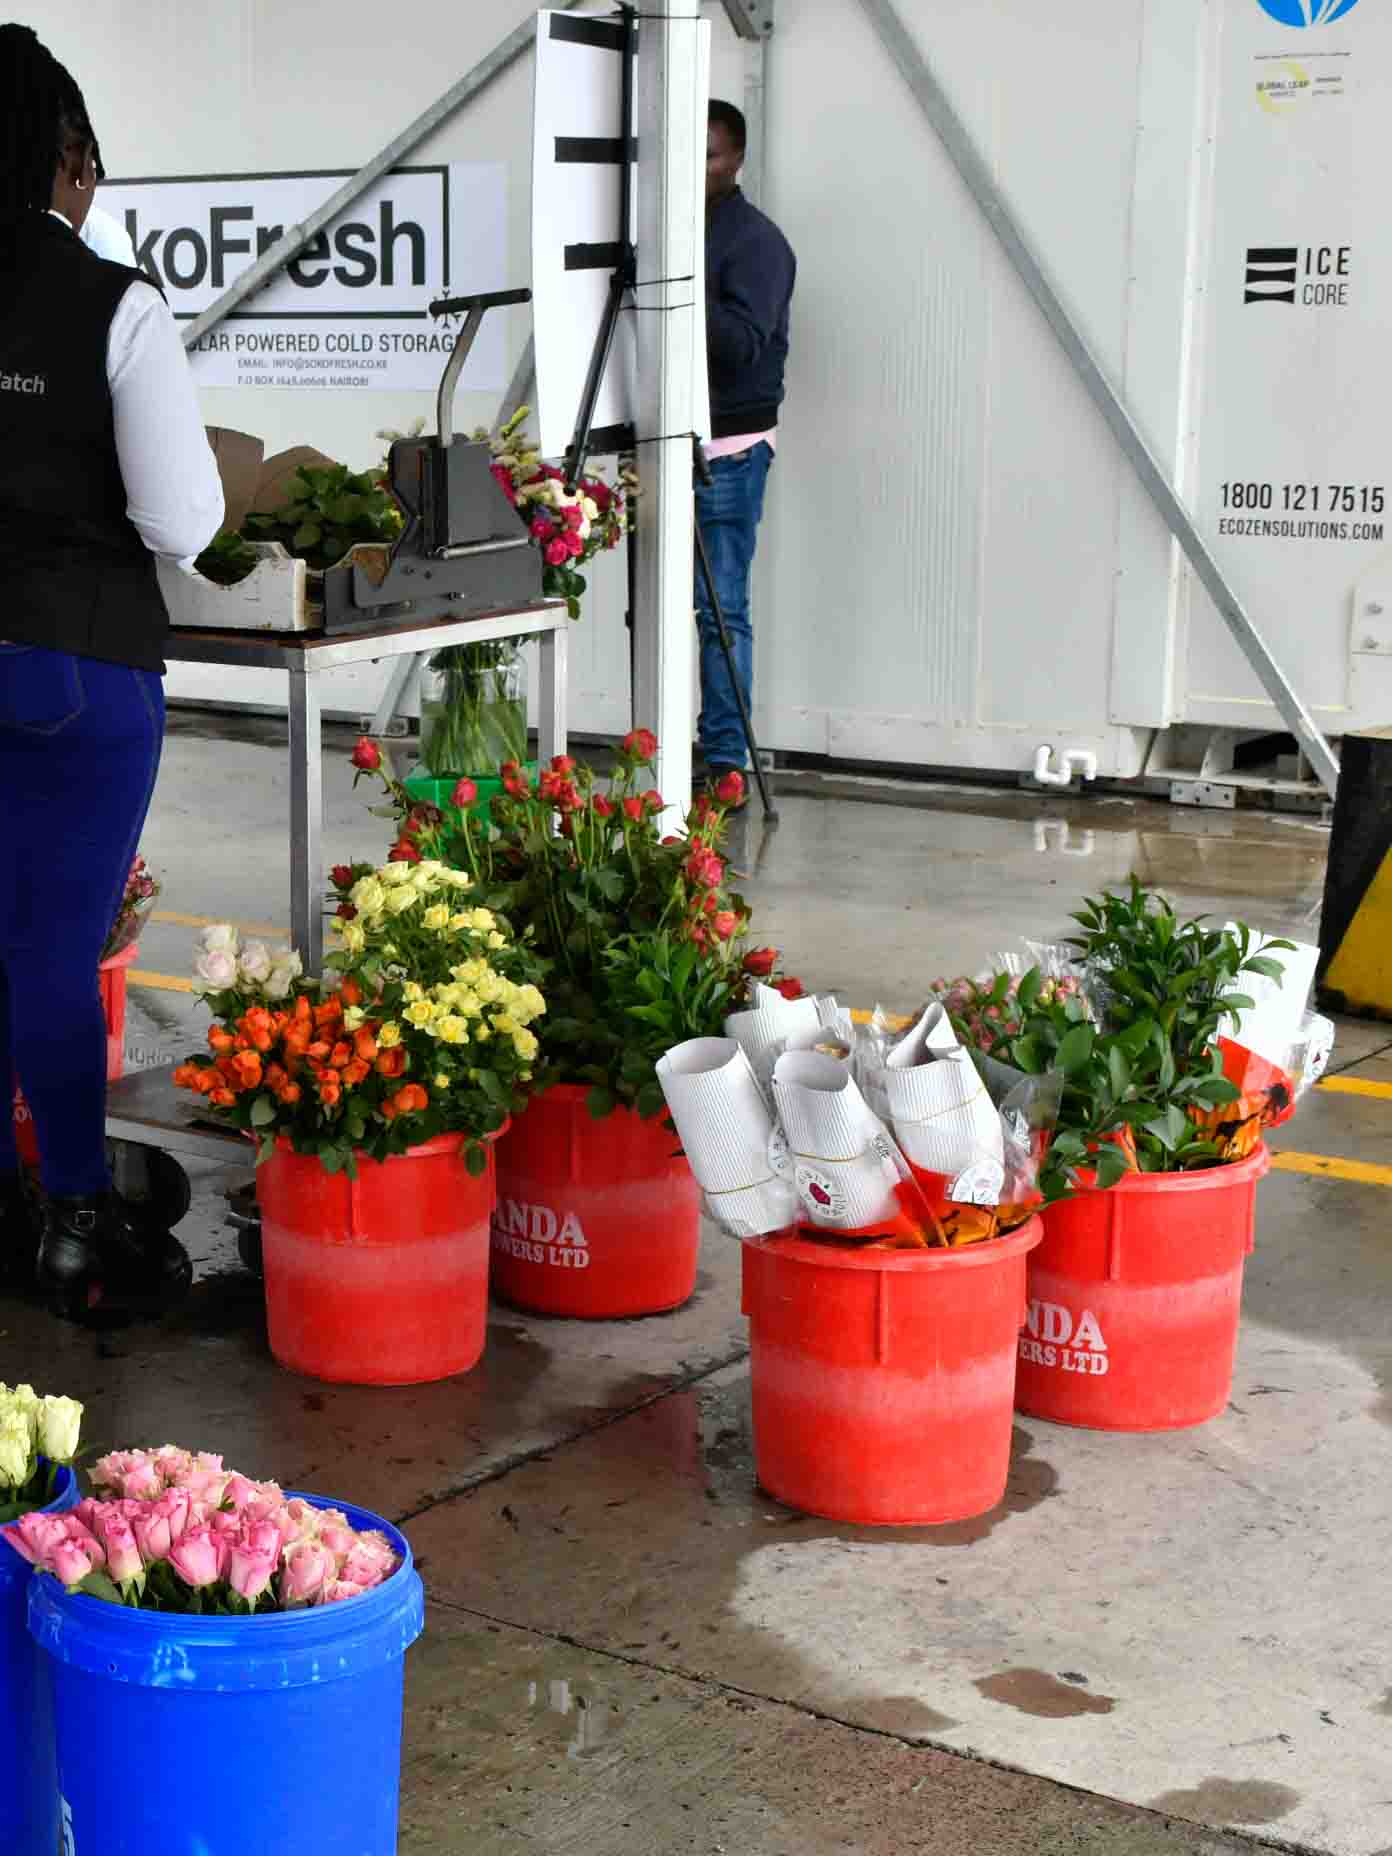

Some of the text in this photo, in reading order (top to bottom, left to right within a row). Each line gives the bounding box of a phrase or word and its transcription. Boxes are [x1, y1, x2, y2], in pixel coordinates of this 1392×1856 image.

[124, 200, 426, 288] koFresh
[1305, 247, 1351, 275] ICE
[1303, 283, 1349, 305] CORE
[234, 333, 320, 352] POWERED
[325, 333, 374, 352] COLD
[378, 333, 455, 353] STORAG
[1220, 482, 1385, 513] 1800 121 7515
[1218, 518, 1384, 541] ECOZENSOLUTIONS.COM
[495, 1197, 588, 1247] ANDA
[549, 1246, 590, 1269] LTD
[1060, 1348, 1110, 1376] LTD
